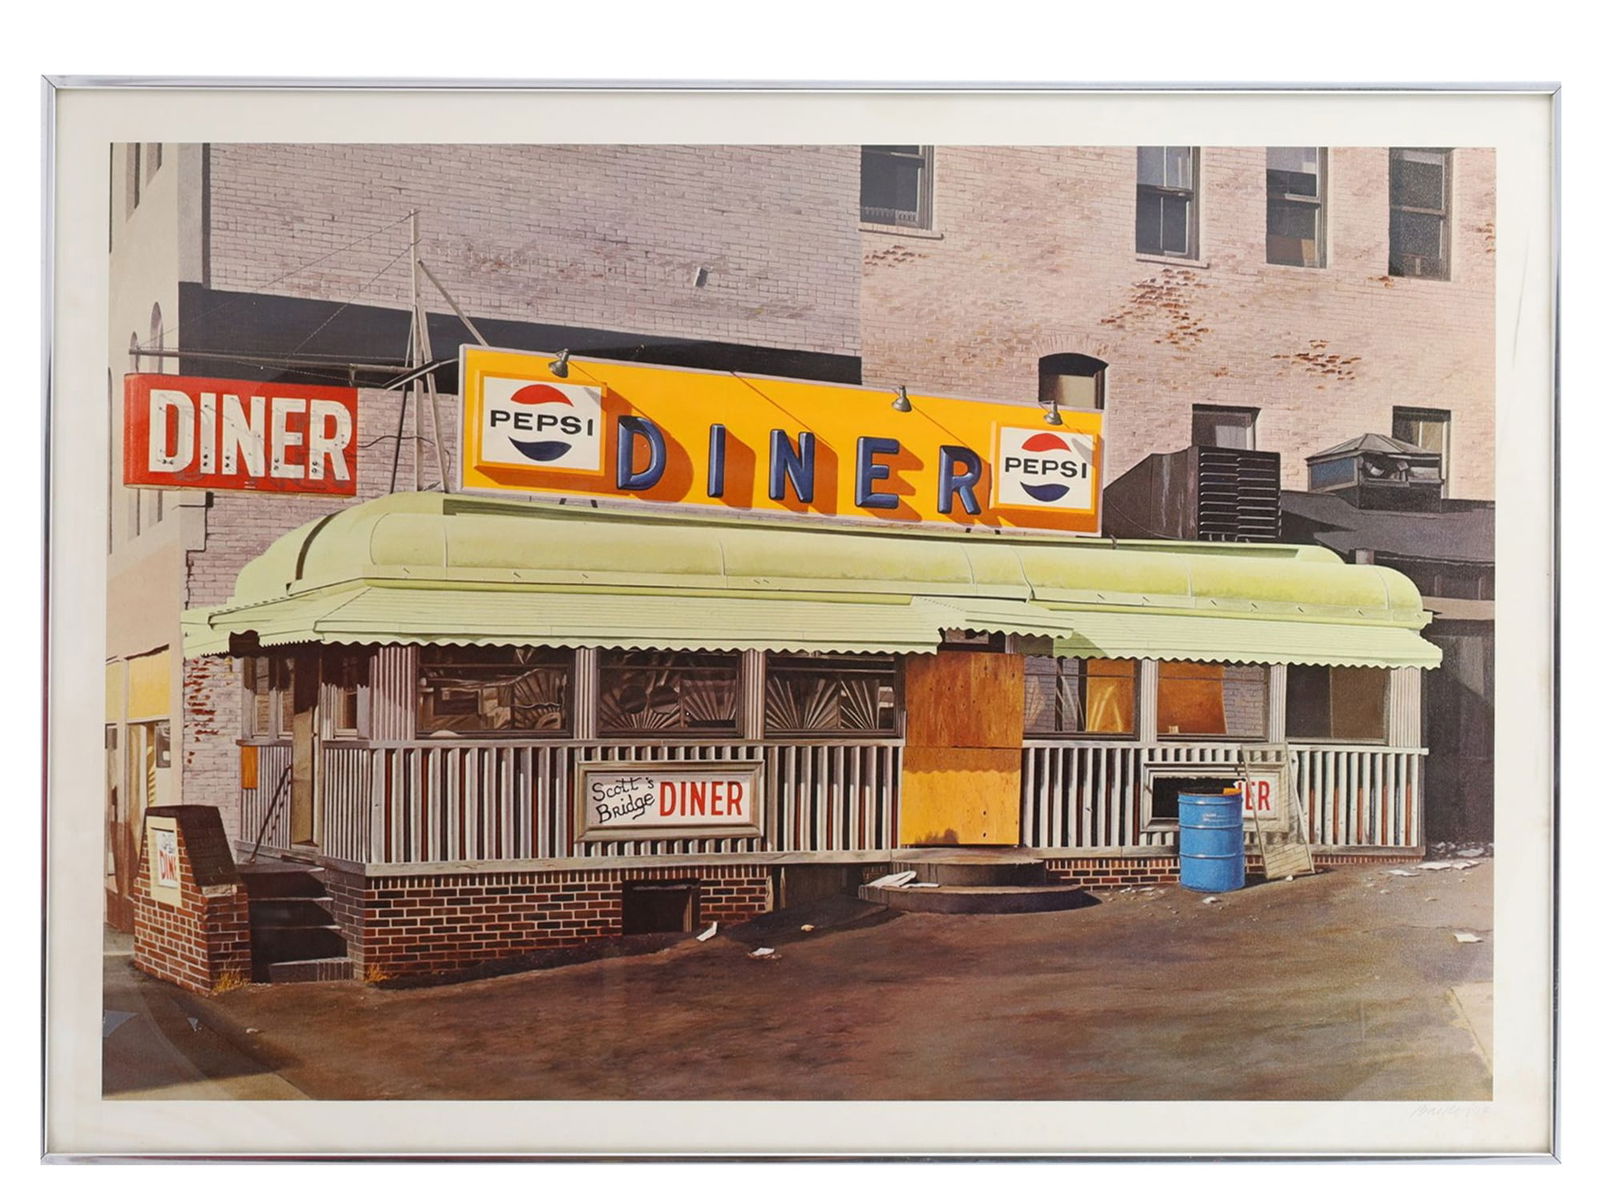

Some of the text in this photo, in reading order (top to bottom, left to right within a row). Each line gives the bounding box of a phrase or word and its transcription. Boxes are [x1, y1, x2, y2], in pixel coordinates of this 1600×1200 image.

[148, 388, 352, 481] DINER
[489, 409, 594, 437] PEPSI
[616, 414, 983, 515] DINER
[1004, 456, 1087, 480] PEPSI
[592, 776, 655, 802] Scott's
[659, 780, 743, 817] DINER
[1238, 780, 1271, 811] ER
[595, 792, 656, 824] Bridge
